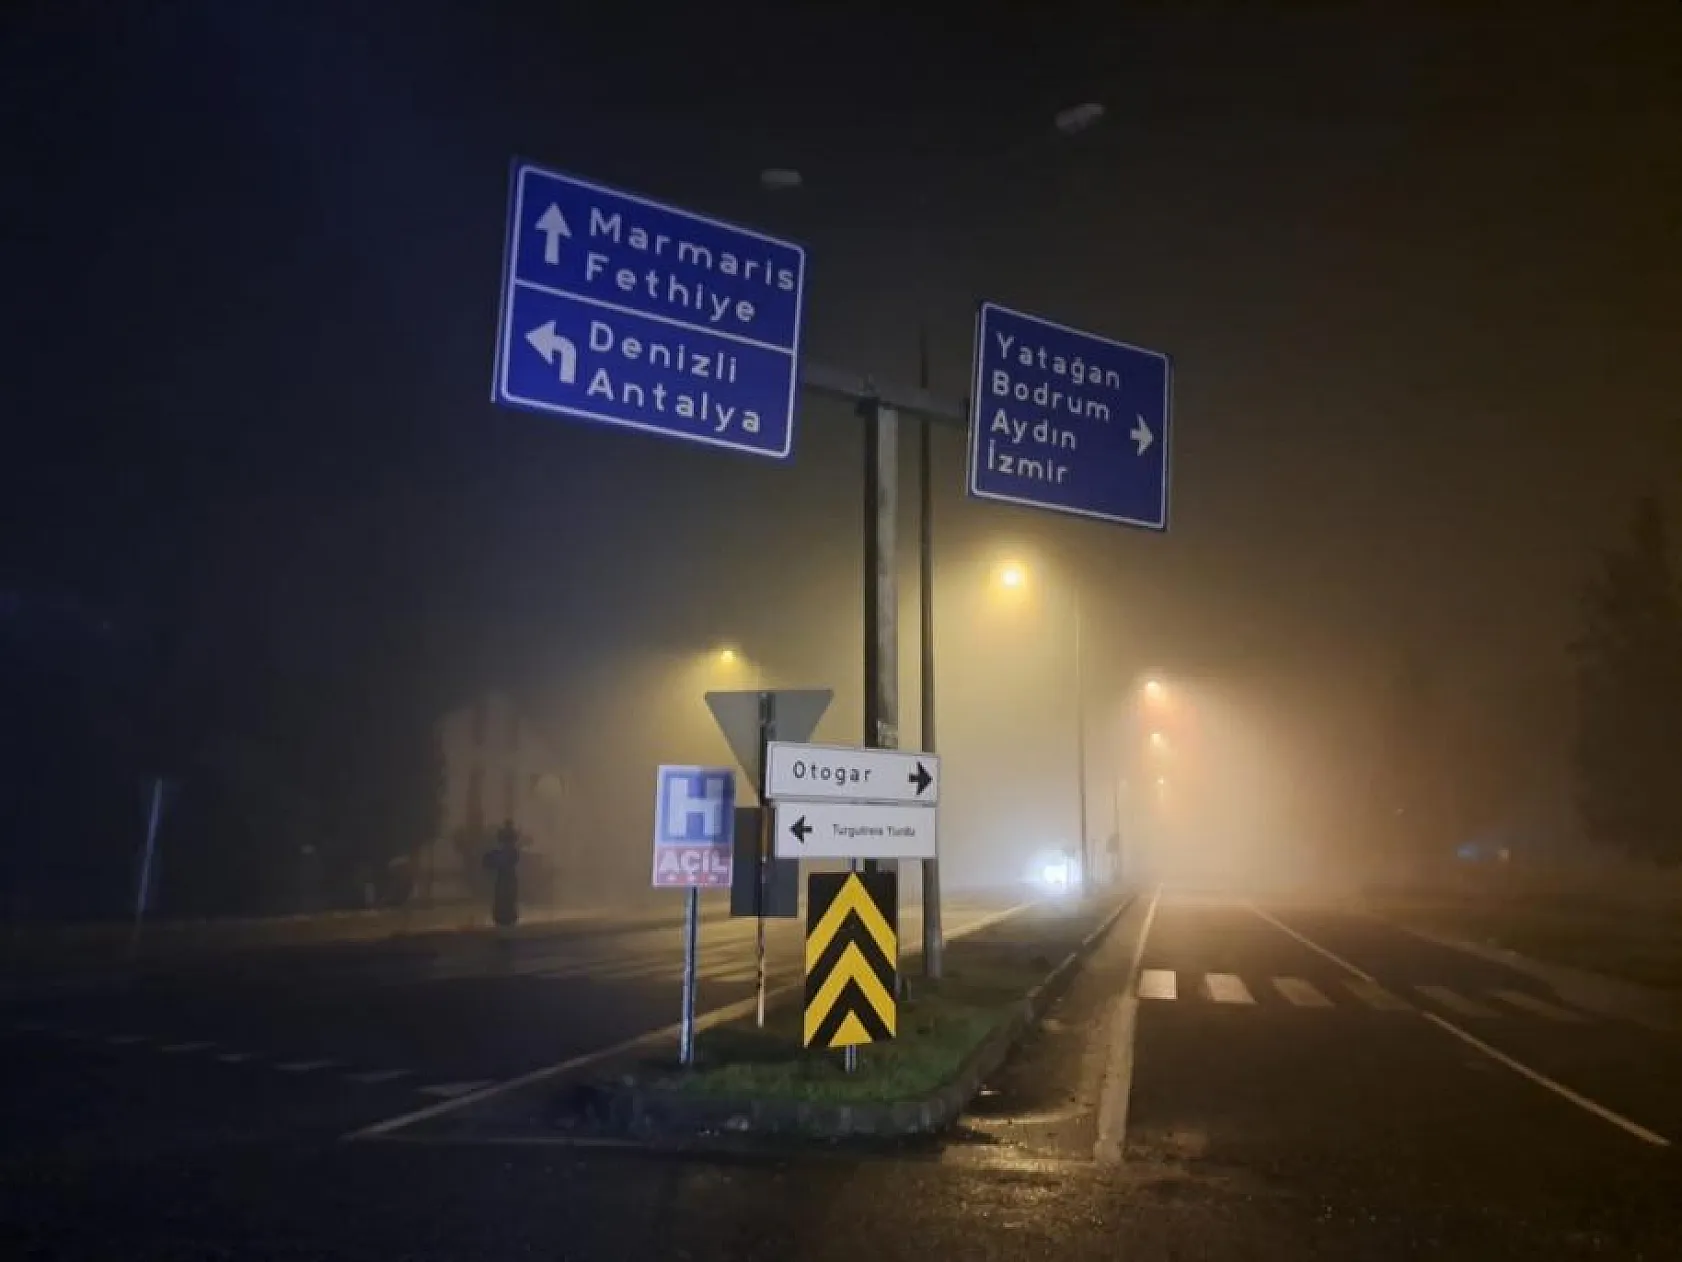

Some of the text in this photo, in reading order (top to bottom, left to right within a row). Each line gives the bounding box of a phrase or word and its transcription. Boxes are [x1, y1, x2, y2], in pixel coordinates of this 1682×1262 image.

[589, 207, 795, 290] Marmaris
[586, 253, 756, 322] Fethiye
[589, 321, 738, 383] Denizli
[996, 331, 1120, 389] Yatağan
[586, 368, 761, 433] Antalya
[991, 369, 1111, 422] Bodrum
[990, 408, 1076, 449] Aydın
[987, 438, 1068, 483] İzmir
[792, 760, 873, 785] Otogar
[669, 778, 723, 836] H
